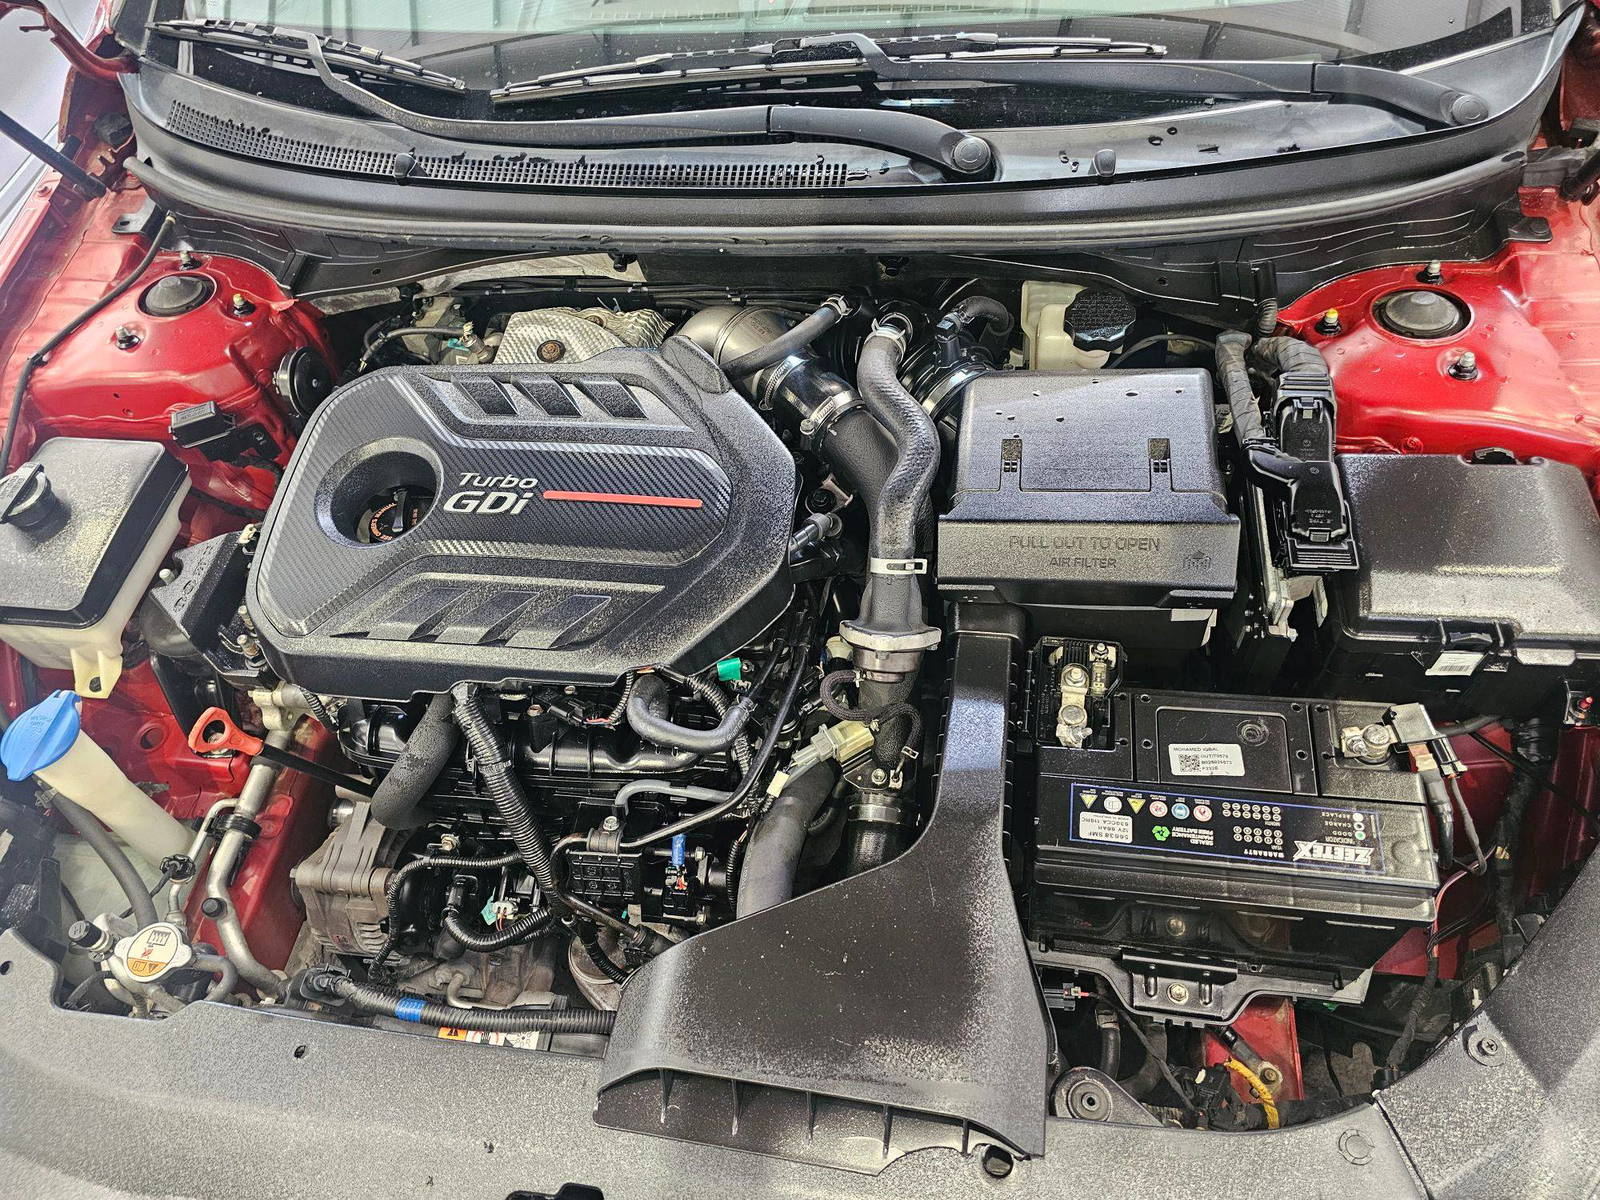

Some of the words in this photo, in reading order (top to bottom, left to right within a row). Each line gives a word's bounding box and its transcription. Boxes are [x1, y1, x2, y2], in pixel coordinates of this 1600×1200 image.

[458, 472, 538, 489] Turbo
[443, 491, 534, 515] GDi
[1009, 535, 1050, 549] PULL
[1053, 536, 1085, 550] OUT
[1090, 536, 1112, 550] TO
[1116, 537, 1160, 551] OPEN
[1050, 557, 1071, 567] AIR
[1073, 557, 1117, 568] FILTER
[1171, 832, 1214, 840] MAINTENANCE
[1243, 848, 1285, 858] WARRANTY
[1293, 839, 1375, 865] ZEETEX
